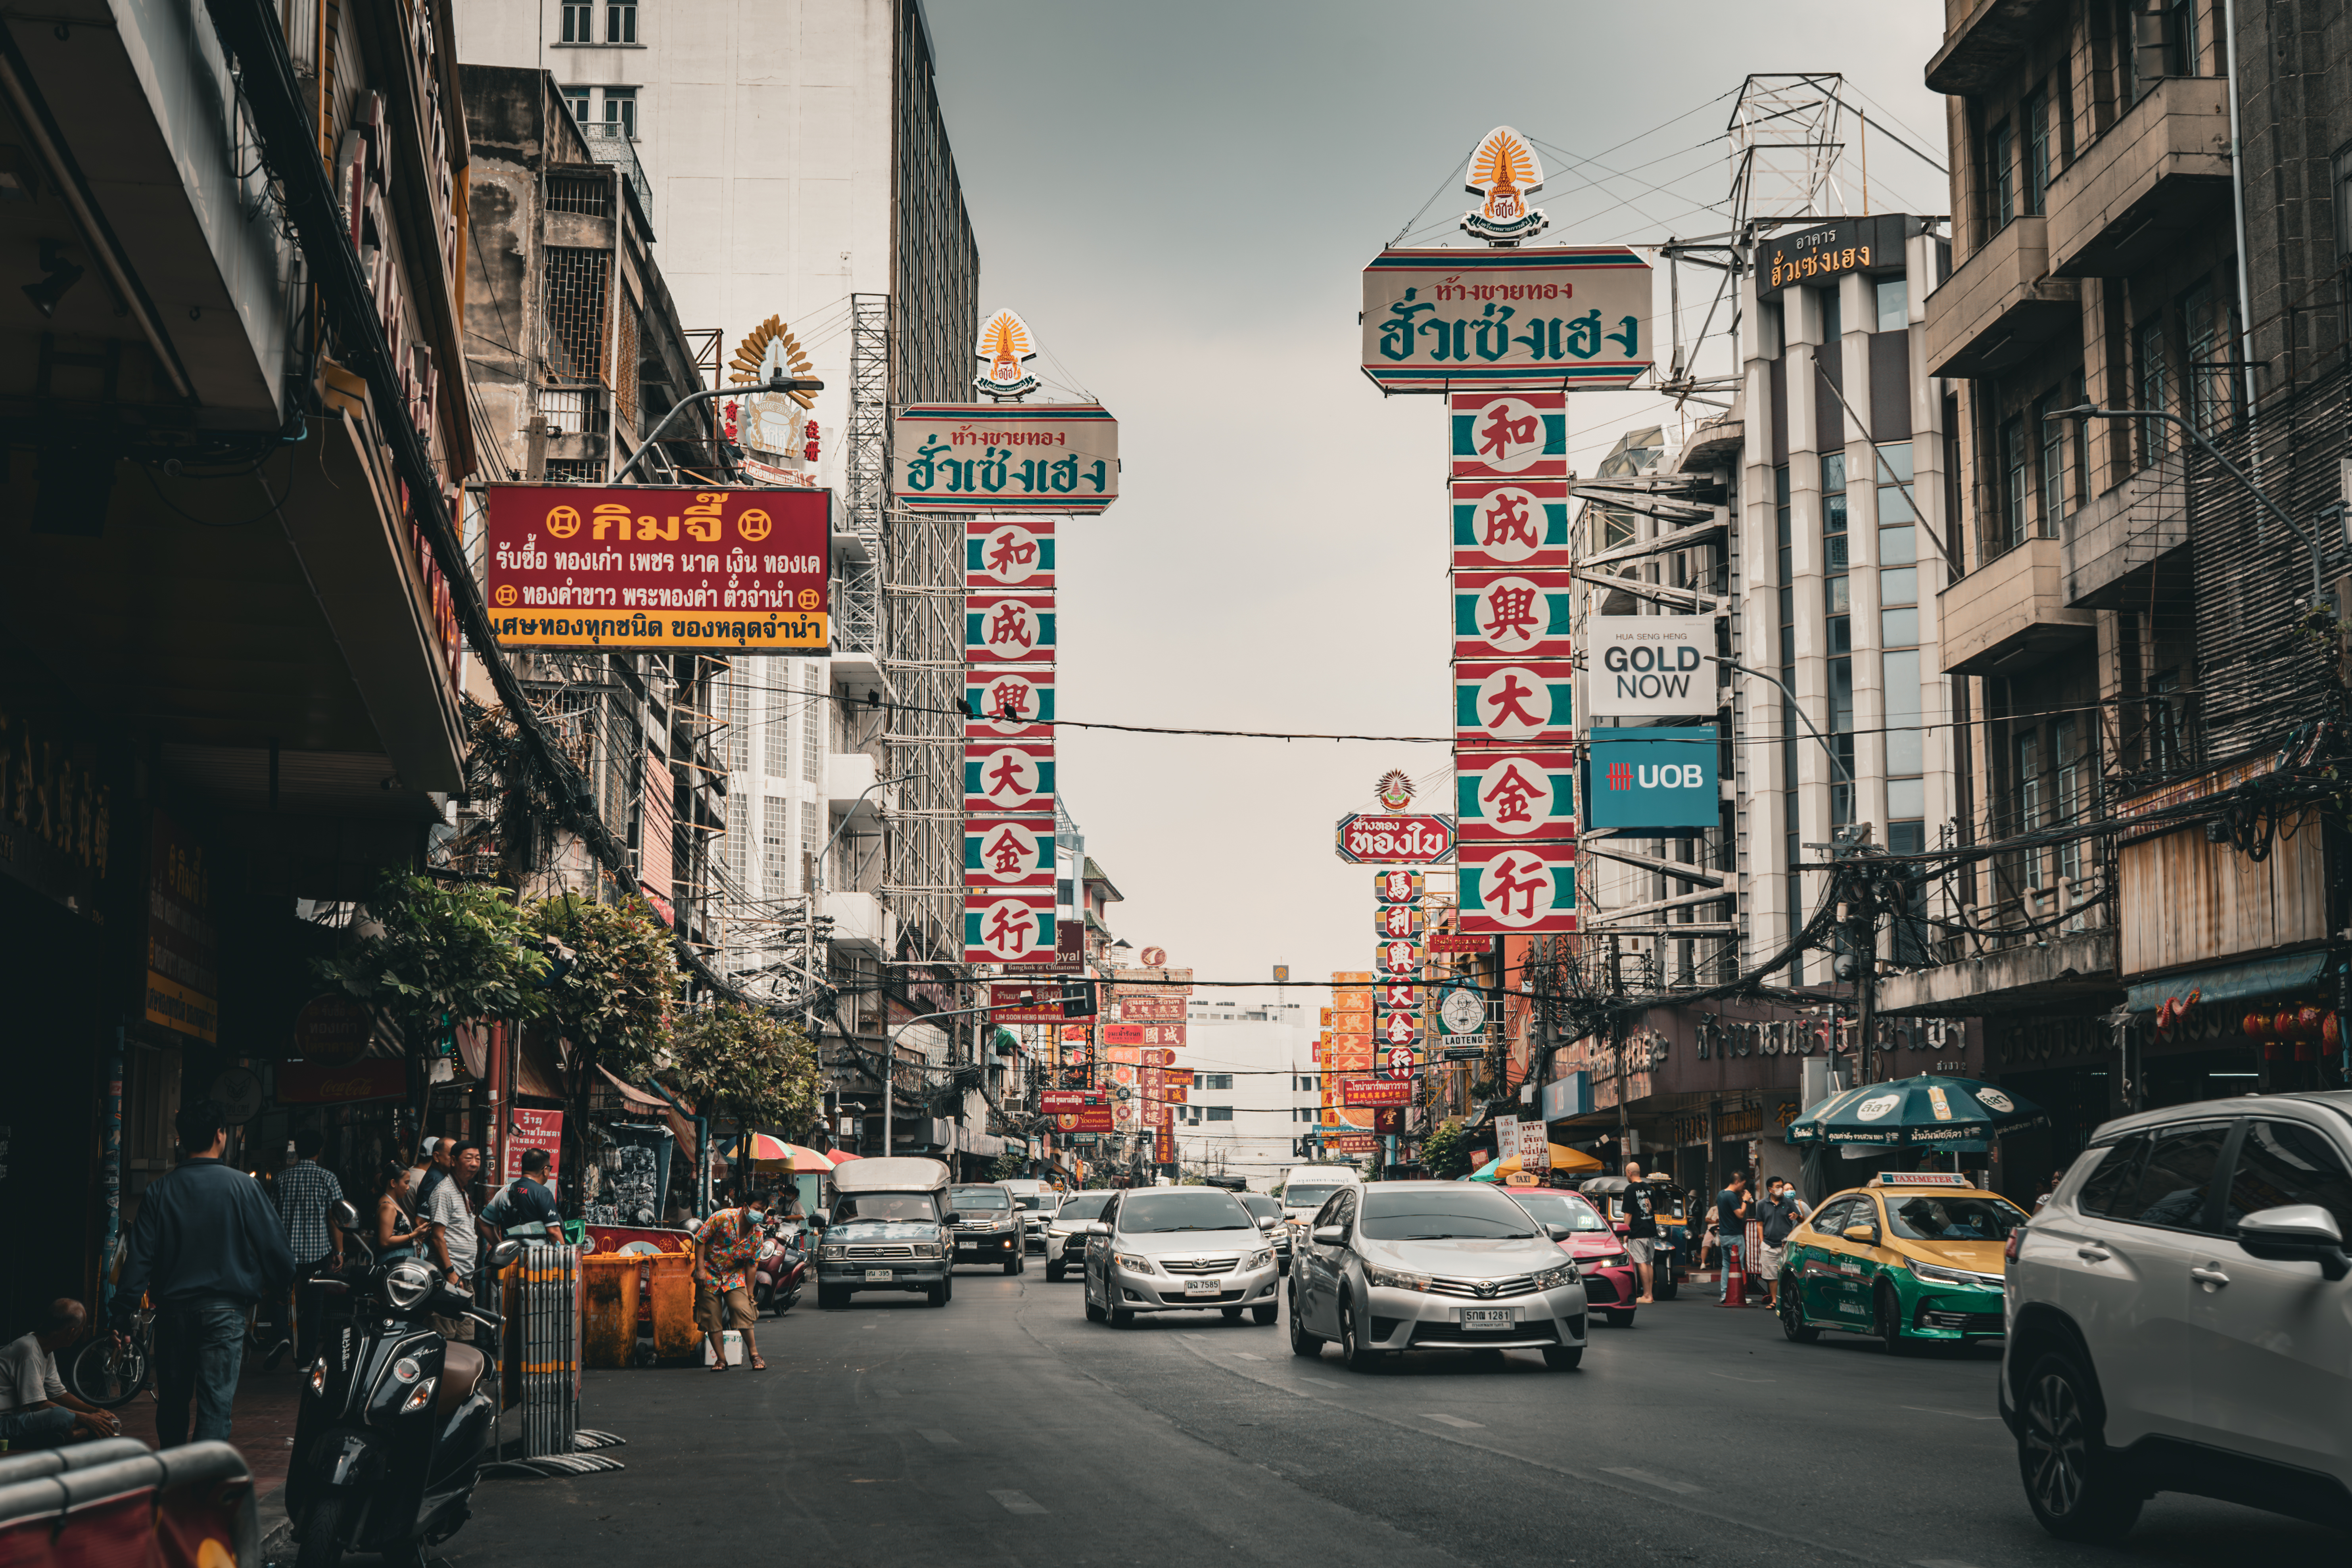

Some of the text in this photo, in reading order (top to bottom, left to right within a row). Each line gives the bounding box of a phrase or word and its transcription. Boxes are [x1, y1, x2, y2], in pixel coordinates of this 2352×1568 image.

[1796, 228, 1837, 251] อาคาร
[1771, 246, 1870, 287] ฮั่วเซ่งเฮง
[1434, 275, 1573, 301] ห้างขายทอง
[1378, 287, 1638, 362] ฮั่วเซ่งเฮง
[951, 425, 1066, 447] ห้างขายทอง
[907, 433, 1107, 494] ฮั่วเซ่งเฮง
[593, 492, 729, 542] กิมจี๊
[496, 534, 821, 575] รับซื้อ ทองเก่า เพชร นาค เงิน ทองเค
[523, 574, 794, 608] ทองคำขาว พระทองคำ ตั๋วจำนำ
[493, 612, 821, 645] เศษทองทุกชนิด ของหลุดจำนำ
[1604, 646, 1700, 672] GOLD
[1617, 674, 1690, 699] NOW
[1638, 764, 1704, 789] UOB
[1352, 818, 1400, 831] ห้างทอง
[1350, 821, 1443, 855] ทองใบ
[1057, 950, 1080, 962] oyal
[1445, 1035, 1483, 1045] LAOTENG
[1961, 1062, 1967, 1071] 2
[1861, 1101, 1891, 1113] ลีลา
[1911, 1128, 1962, 1141] น้ำมันพืชลีลา
[1893, 1175, 1953, 1183] TAXI-METER
[1488, 1311, 1508, 1320] 1281
